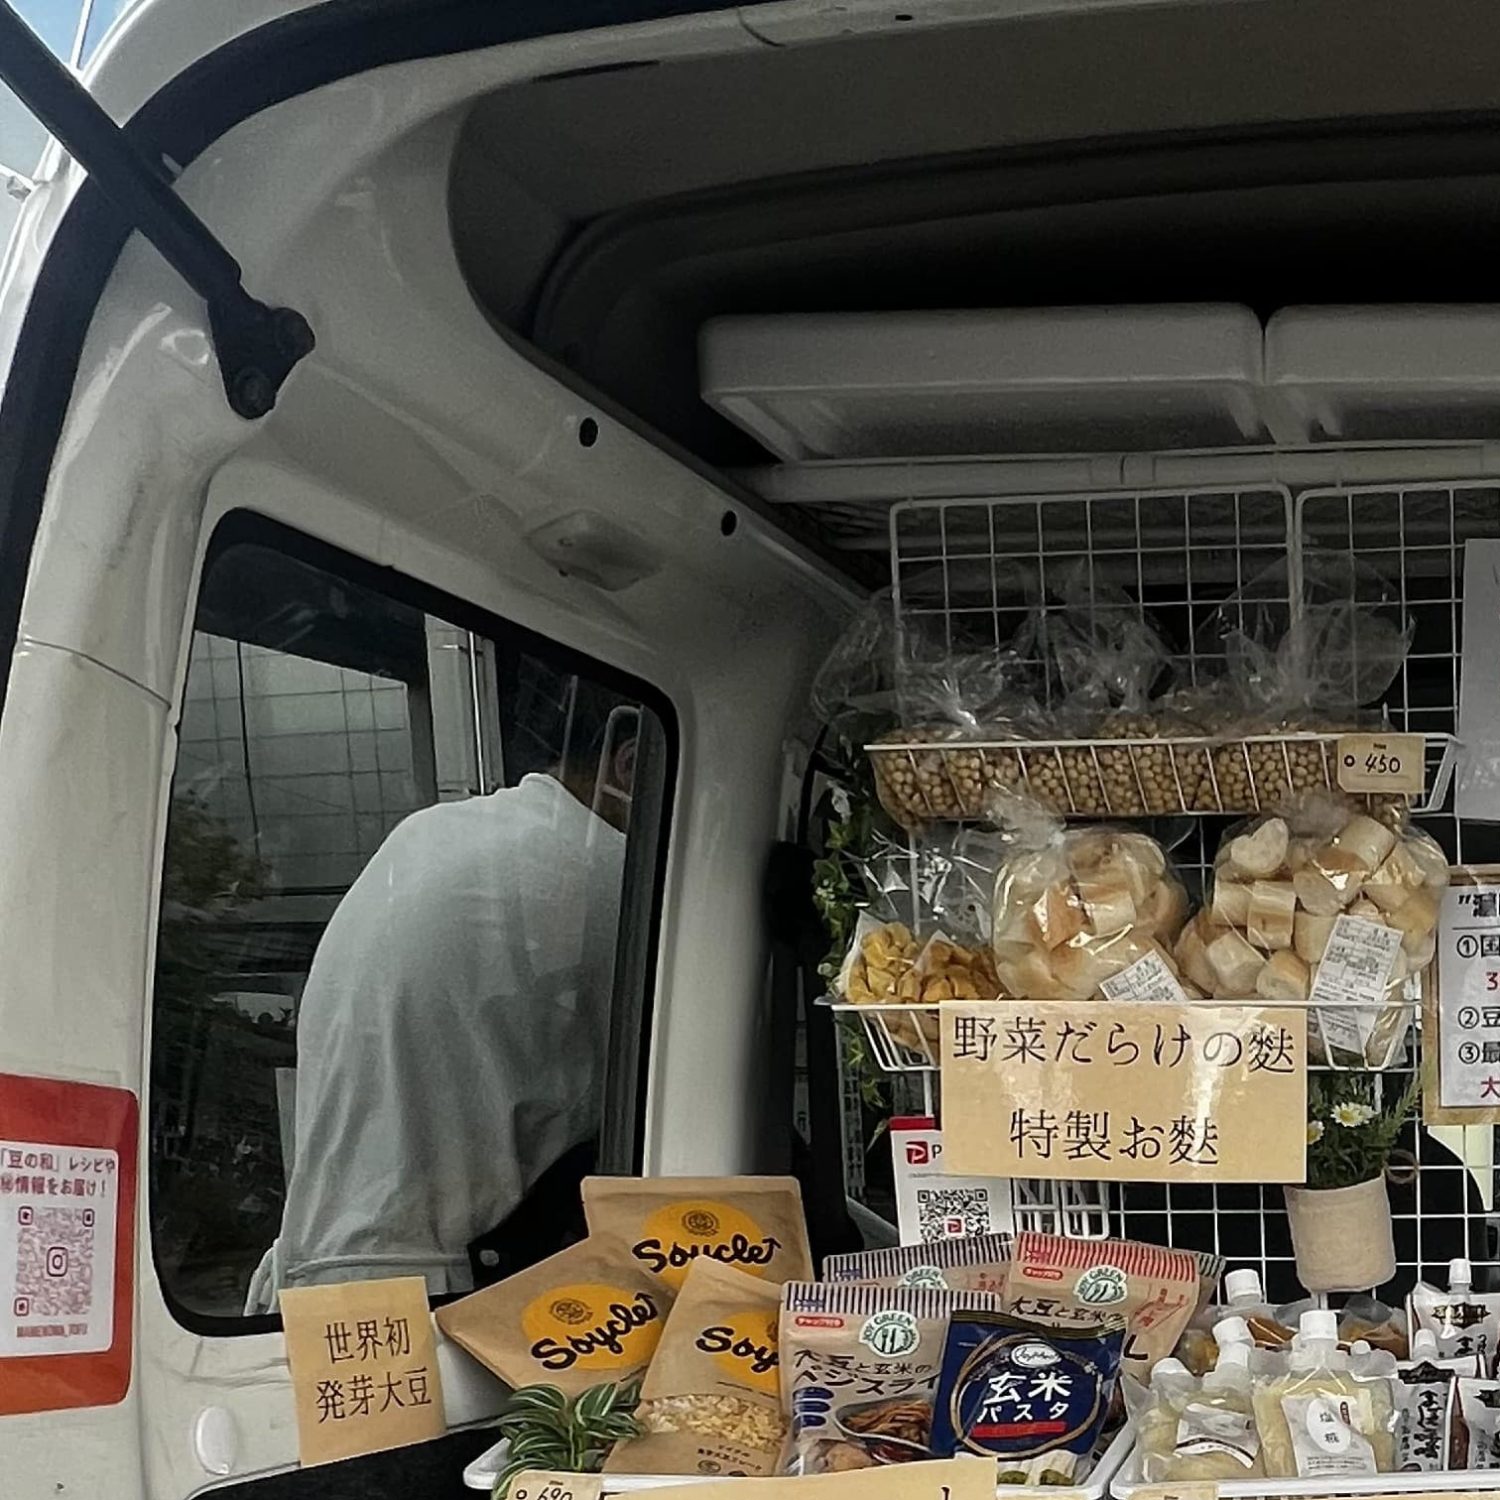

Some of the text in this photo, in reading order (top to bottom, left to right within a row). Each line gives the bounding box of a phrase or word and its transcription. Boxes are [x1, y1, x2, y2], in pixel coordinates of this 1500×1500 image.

[1366, 754, 1400, 773] 450
[324, 1316, 410, 1364] 世界初
[695, 1326, 779, 1373] Soy
[794, 1349, 932, 1375] 大豆と玄米の
[794, 1364, 942, 1395] ベジスライ
[983, 1372, 1073, 1402] 玄米
[315, 1367, 432, 1423] 発芽大豆
[977, 1402, 1069, 1422] パスタ
